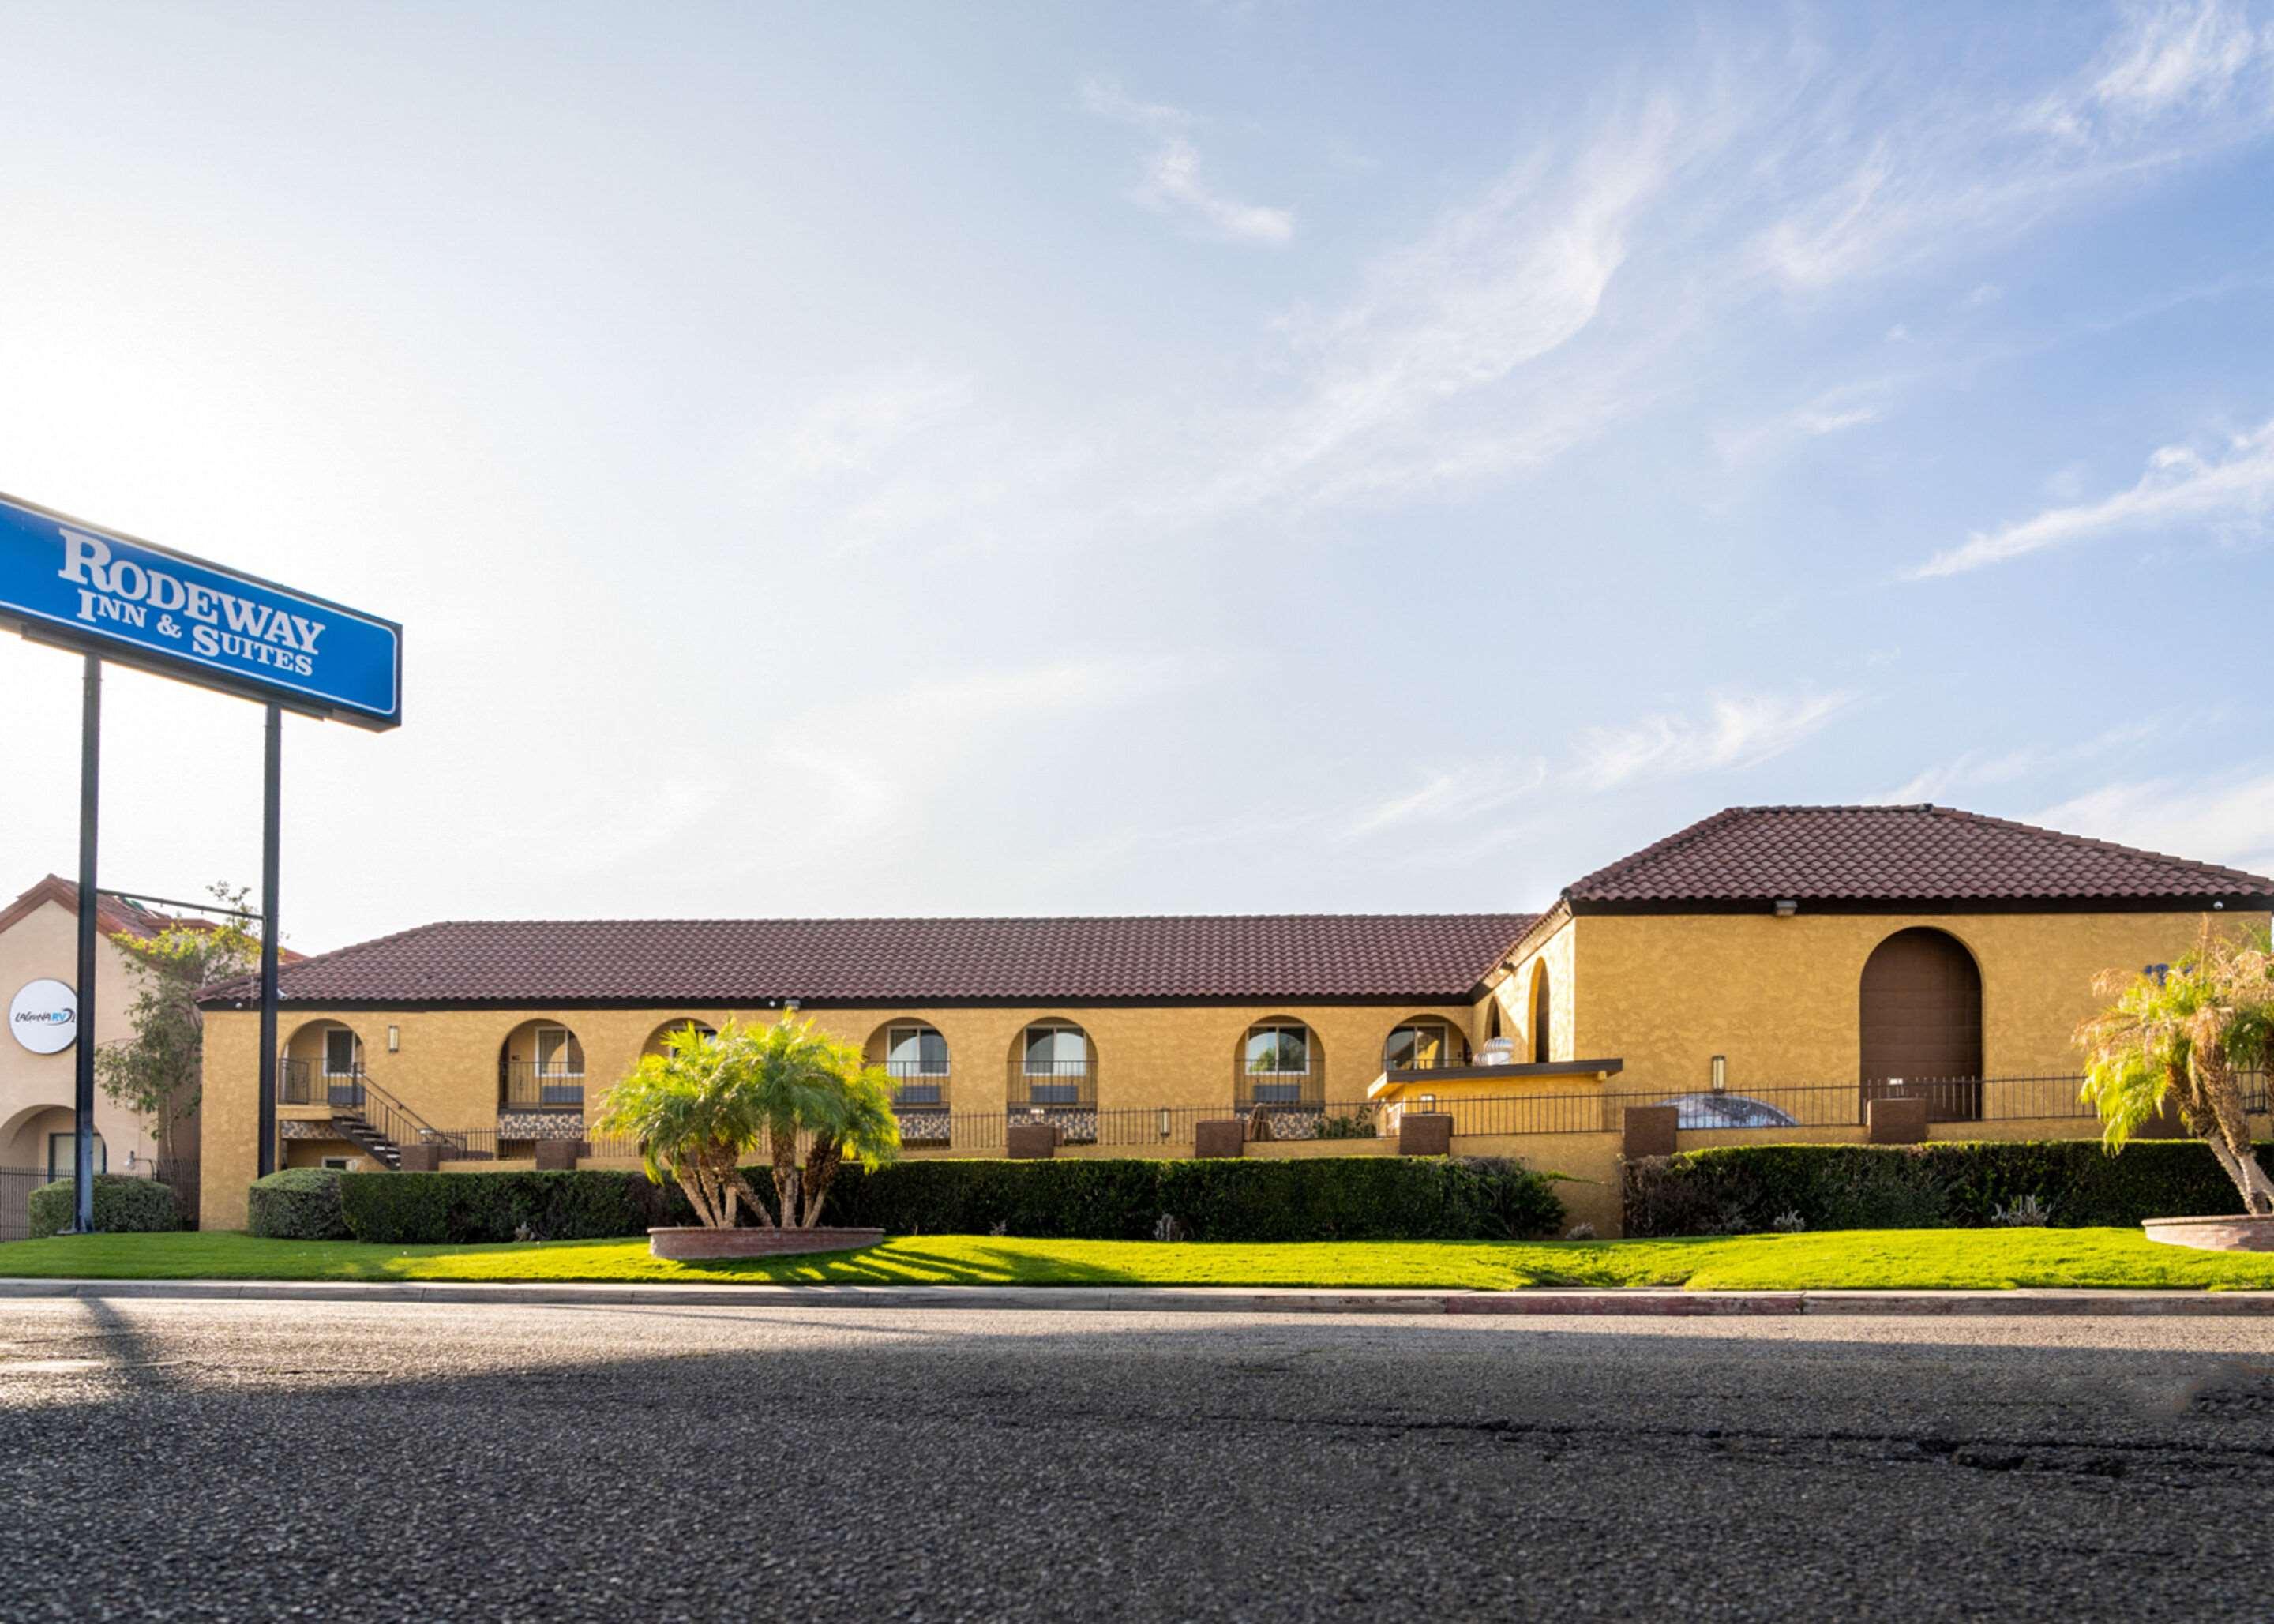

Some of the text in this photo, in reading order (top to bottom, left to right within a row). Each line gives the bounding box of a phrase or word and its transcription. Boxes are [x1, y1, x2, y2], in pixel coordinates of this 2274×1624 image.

[58, 527, 326, 655] RODEWAY
[77, 588, 313, 676] INN & SUITES
